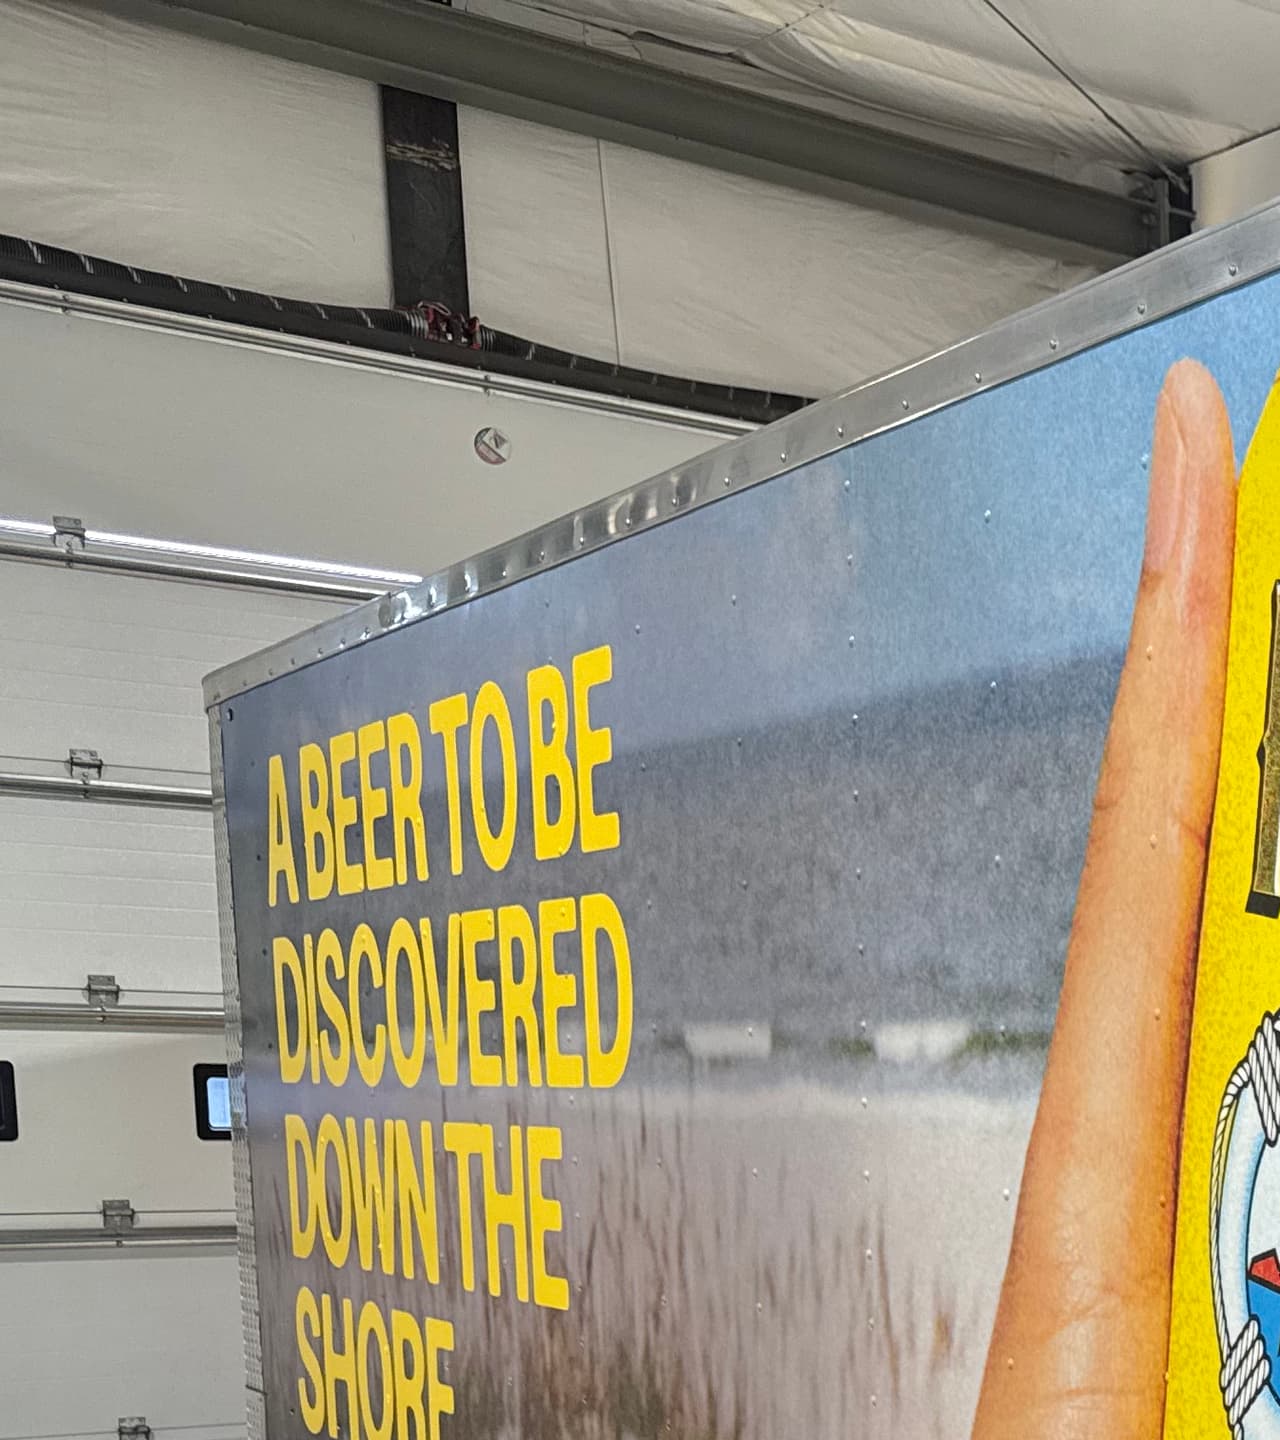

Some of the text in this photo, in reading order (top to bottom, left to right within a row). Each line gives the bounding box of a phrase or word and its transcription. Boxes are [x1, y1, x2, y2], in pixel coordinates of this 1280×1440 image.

[267, 644, 621, 907] A BEER TO BE
[272, 892, 635, 1090] DISCOVERED
[285, 1112, 570, 1312] DOWN THE
